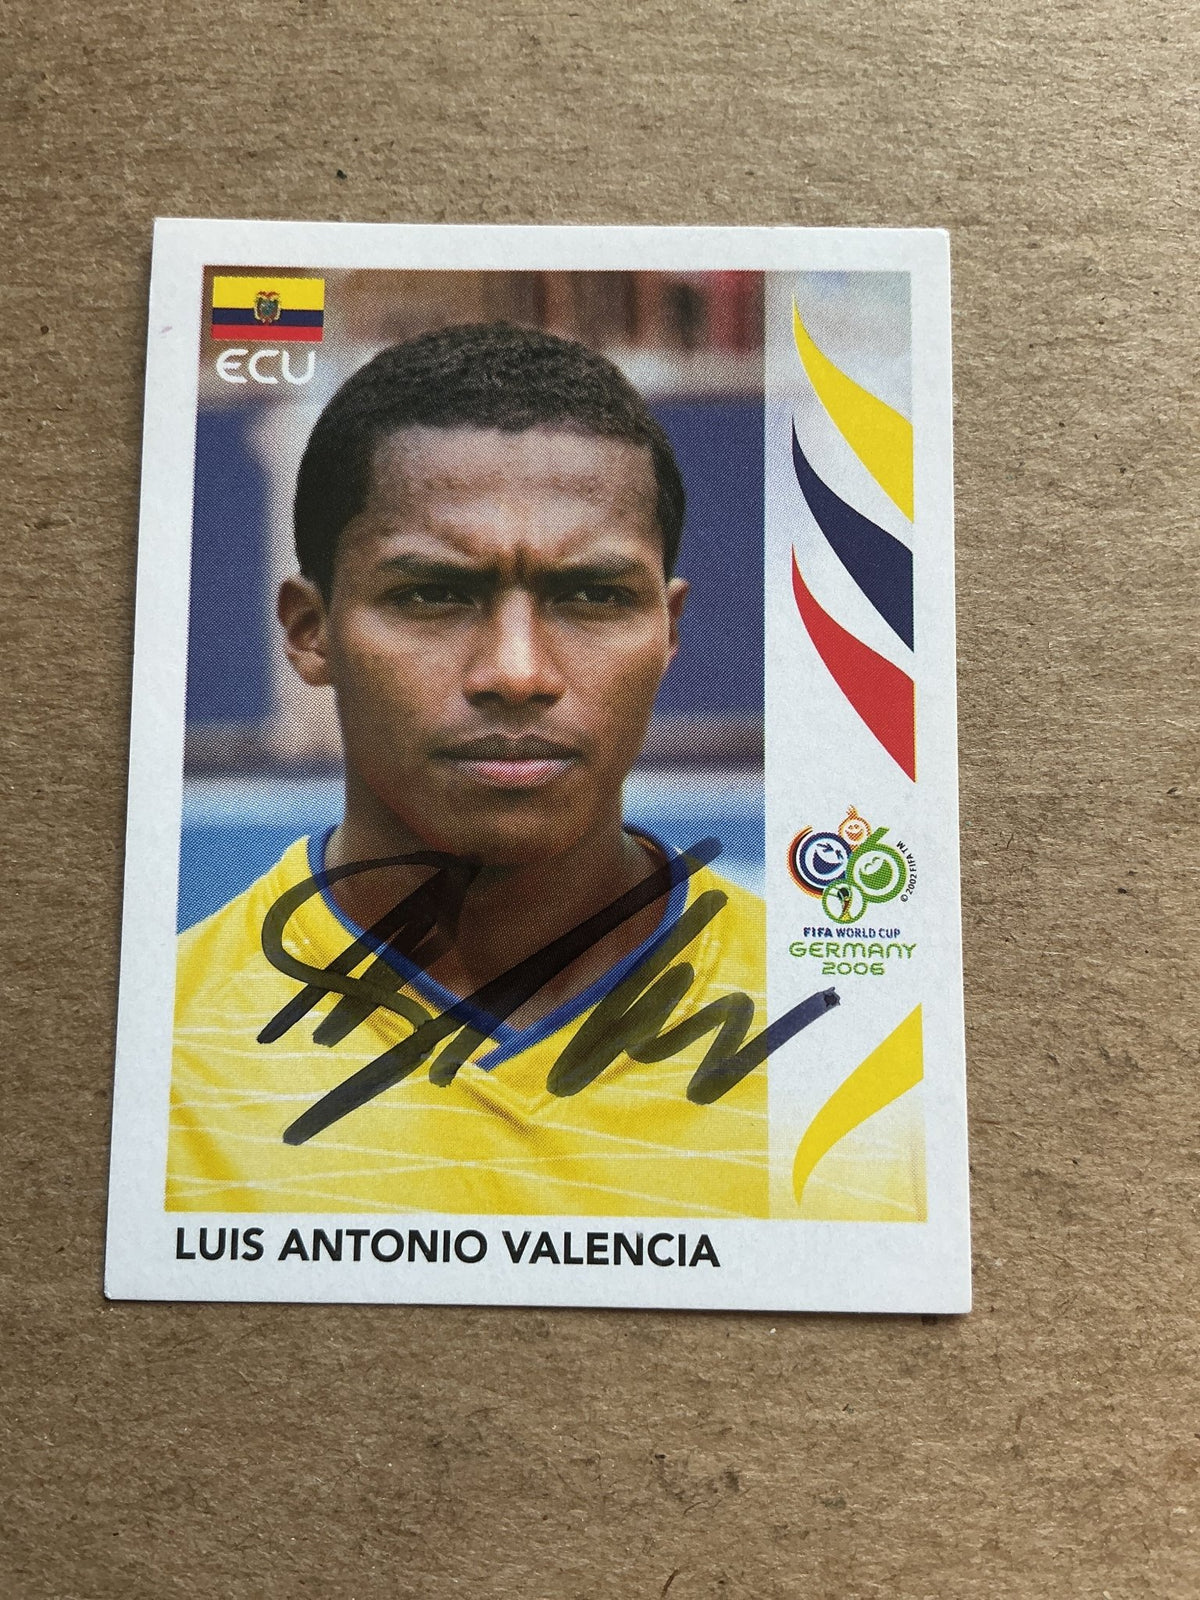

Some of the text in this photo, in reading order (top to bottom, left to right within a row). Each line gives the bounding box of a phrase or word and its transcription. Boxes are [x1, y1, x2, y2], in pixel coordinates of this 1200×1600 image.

[216, 348, 316, 384] ECU
[906, 853, 916, 872] FIFA
[906, 873, 917, 895] 2002
[803, 927, 901, 939] FIFA WORLD CUP
[789, 941, 917, 959] GERMANY
[821, 961, 885, 976] 2006
[175, 1227, 721, 1268] LUIS ANTONIO VALENCIA
